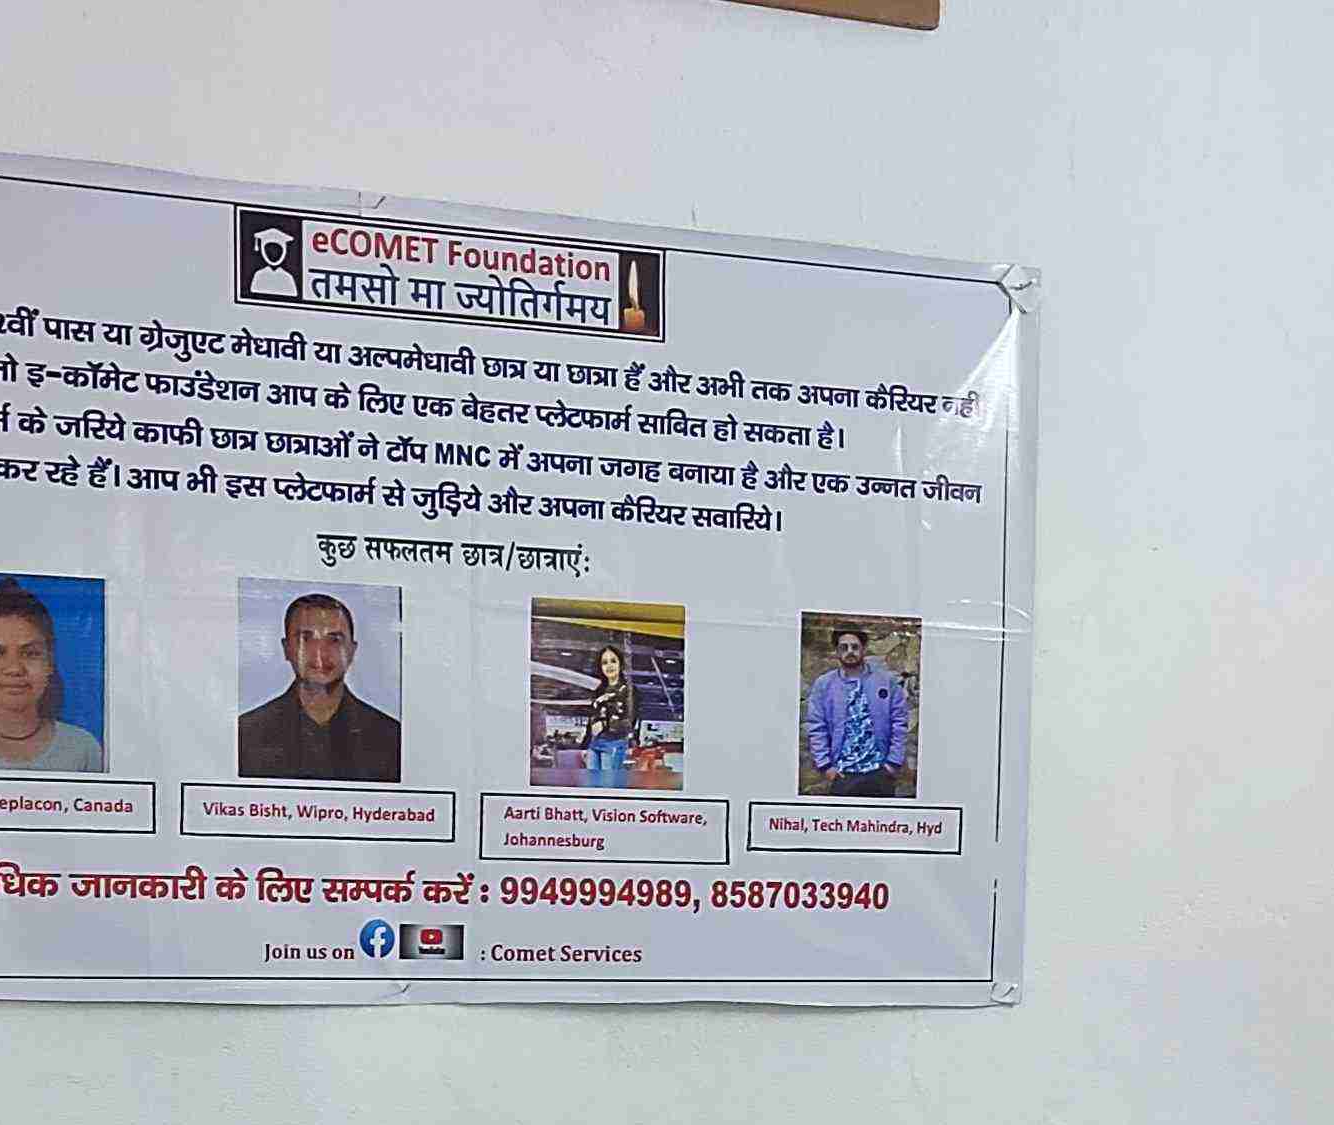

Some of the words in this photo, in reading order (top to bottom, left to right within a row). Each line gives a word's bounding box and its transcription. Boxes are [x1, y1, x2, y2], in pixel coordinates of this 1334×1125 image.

[312, 227, 438, 265] eCOMET
[448, 240, 611, 282] Foundation
[308, 264, 400, 306] तमसो
[408, 278, 445, 310] मा
[455, 275, 612, 325] ज्योतिर्गमय
[42, 318, 96, 342] पास
[102, 323, 133, 345] या
[139, 320, 226, 362] ग्रेजुएट
[230, 327, 307, 360] मेधावी
[313, 342, 342, 364] या
[348, 343, 476, 375] अल्पमेधावी
[482, 357, 527, 379] छात्र
[533, 361, 561, 382] या
[566, 364, 618, 387] छात्रा
[648, 365, 692, 394] और
[696, 370, 745, 398] अभी
[750, 381, 792, 401] तक
[798, 385, 860, 408] अपना
[865, 383, 938, 414] कैरियर
[145, 370, 261, 402] फाउंडेशन
[267, 384, 318, 407] आप
[324, 382, 351, 409] के
[358, 383, 406, 415] लिए
[412, 396, 455, 417] एक
[461, 392, 531, 424] बेहतर
[535, 399, 632, 431] प्लेटफार्म
[637, 408, 707, 437] साबित
[713, 414, 738, 441] हो
[743, 423, 812, 446] सकता
[17, 406, 48, 434] के
[53, 410, 126, 441] जरिये
[132, 417, 204, 447] काफी
[210, 428, 258, 451] छात्र
[265, 430, 354, 458] छात्राओं
[358, 432, 380, 460] ने
[386, 436, 428, 463] टॉप
[435, 443, 490, 467] MNC
[498, 443, 524, 470] में
[527, 453, 593, 475] अपना
[598, 457, 662, 482] जगह
[668, 462, 735, 485] बनाया
[741, 460, 759, 490] है
[764, 463, 808, 491] और
[811, 473, 850, 493] एक
[855, 476, 917, 498] उन्नत
[921, 474, 982, 504] जीवन
[44, 455, 81, 486] रहे
[127, 469, 180, 491] आप
[187, 464, 218, 493] भी
[224, 475, 267, 499] इस
[273, 472, 376, 504] प्लेटफार्म
[382, 479, 406, 506] से
[411, 481, 482, 520] जुड़िये
[488, 486, 535, 515] और
[538, 497, 605, 520] अपना
[611, 494, 687, 526] कैरियर
[317, 534, 357, 567] कुछ
[364, 537, 453, 564] सफलतम
[74, 798, 133, 812] Canada
[203, 802, 244, 816] Vikas
[250, 804, 292, 819] Bisht,
[297, 805, 347, 821] Wipro,
[353, 807, 434, 823] Hyderabad
[504, 807, 539, 820] Aarti
[545, 807, 587, 823] Bhatt,
[593, 809, 635, 822] Vision
[640, 810, 707, 826] Software,
[504, 833, 604, 850] Johannesburg
[770, 818, 808, 832] Nihal,
[812, 819, 842, 831] Tech
[847, 820, 913, 835] Mahindra,
[917, 822, 942, 836] Hyd
[68, 866, 207, 900] जानकारी
[214, 868, 249, 900] के
[255, 867, 314, 903] लिए
[321, 870, 415, 903] सम्पर्क
[422, 872, 475, 904] करें
[501, 877, 700, 913] 9949994989,
[712, 881, 889, 909] 8587033940
[265, 944, 300, 962] Join
[307, 948, 327, 959] us
[332, 948, 354, 959] on
[491, 944, 556, 961] Comet
[560, 945, 641, 963] Services
